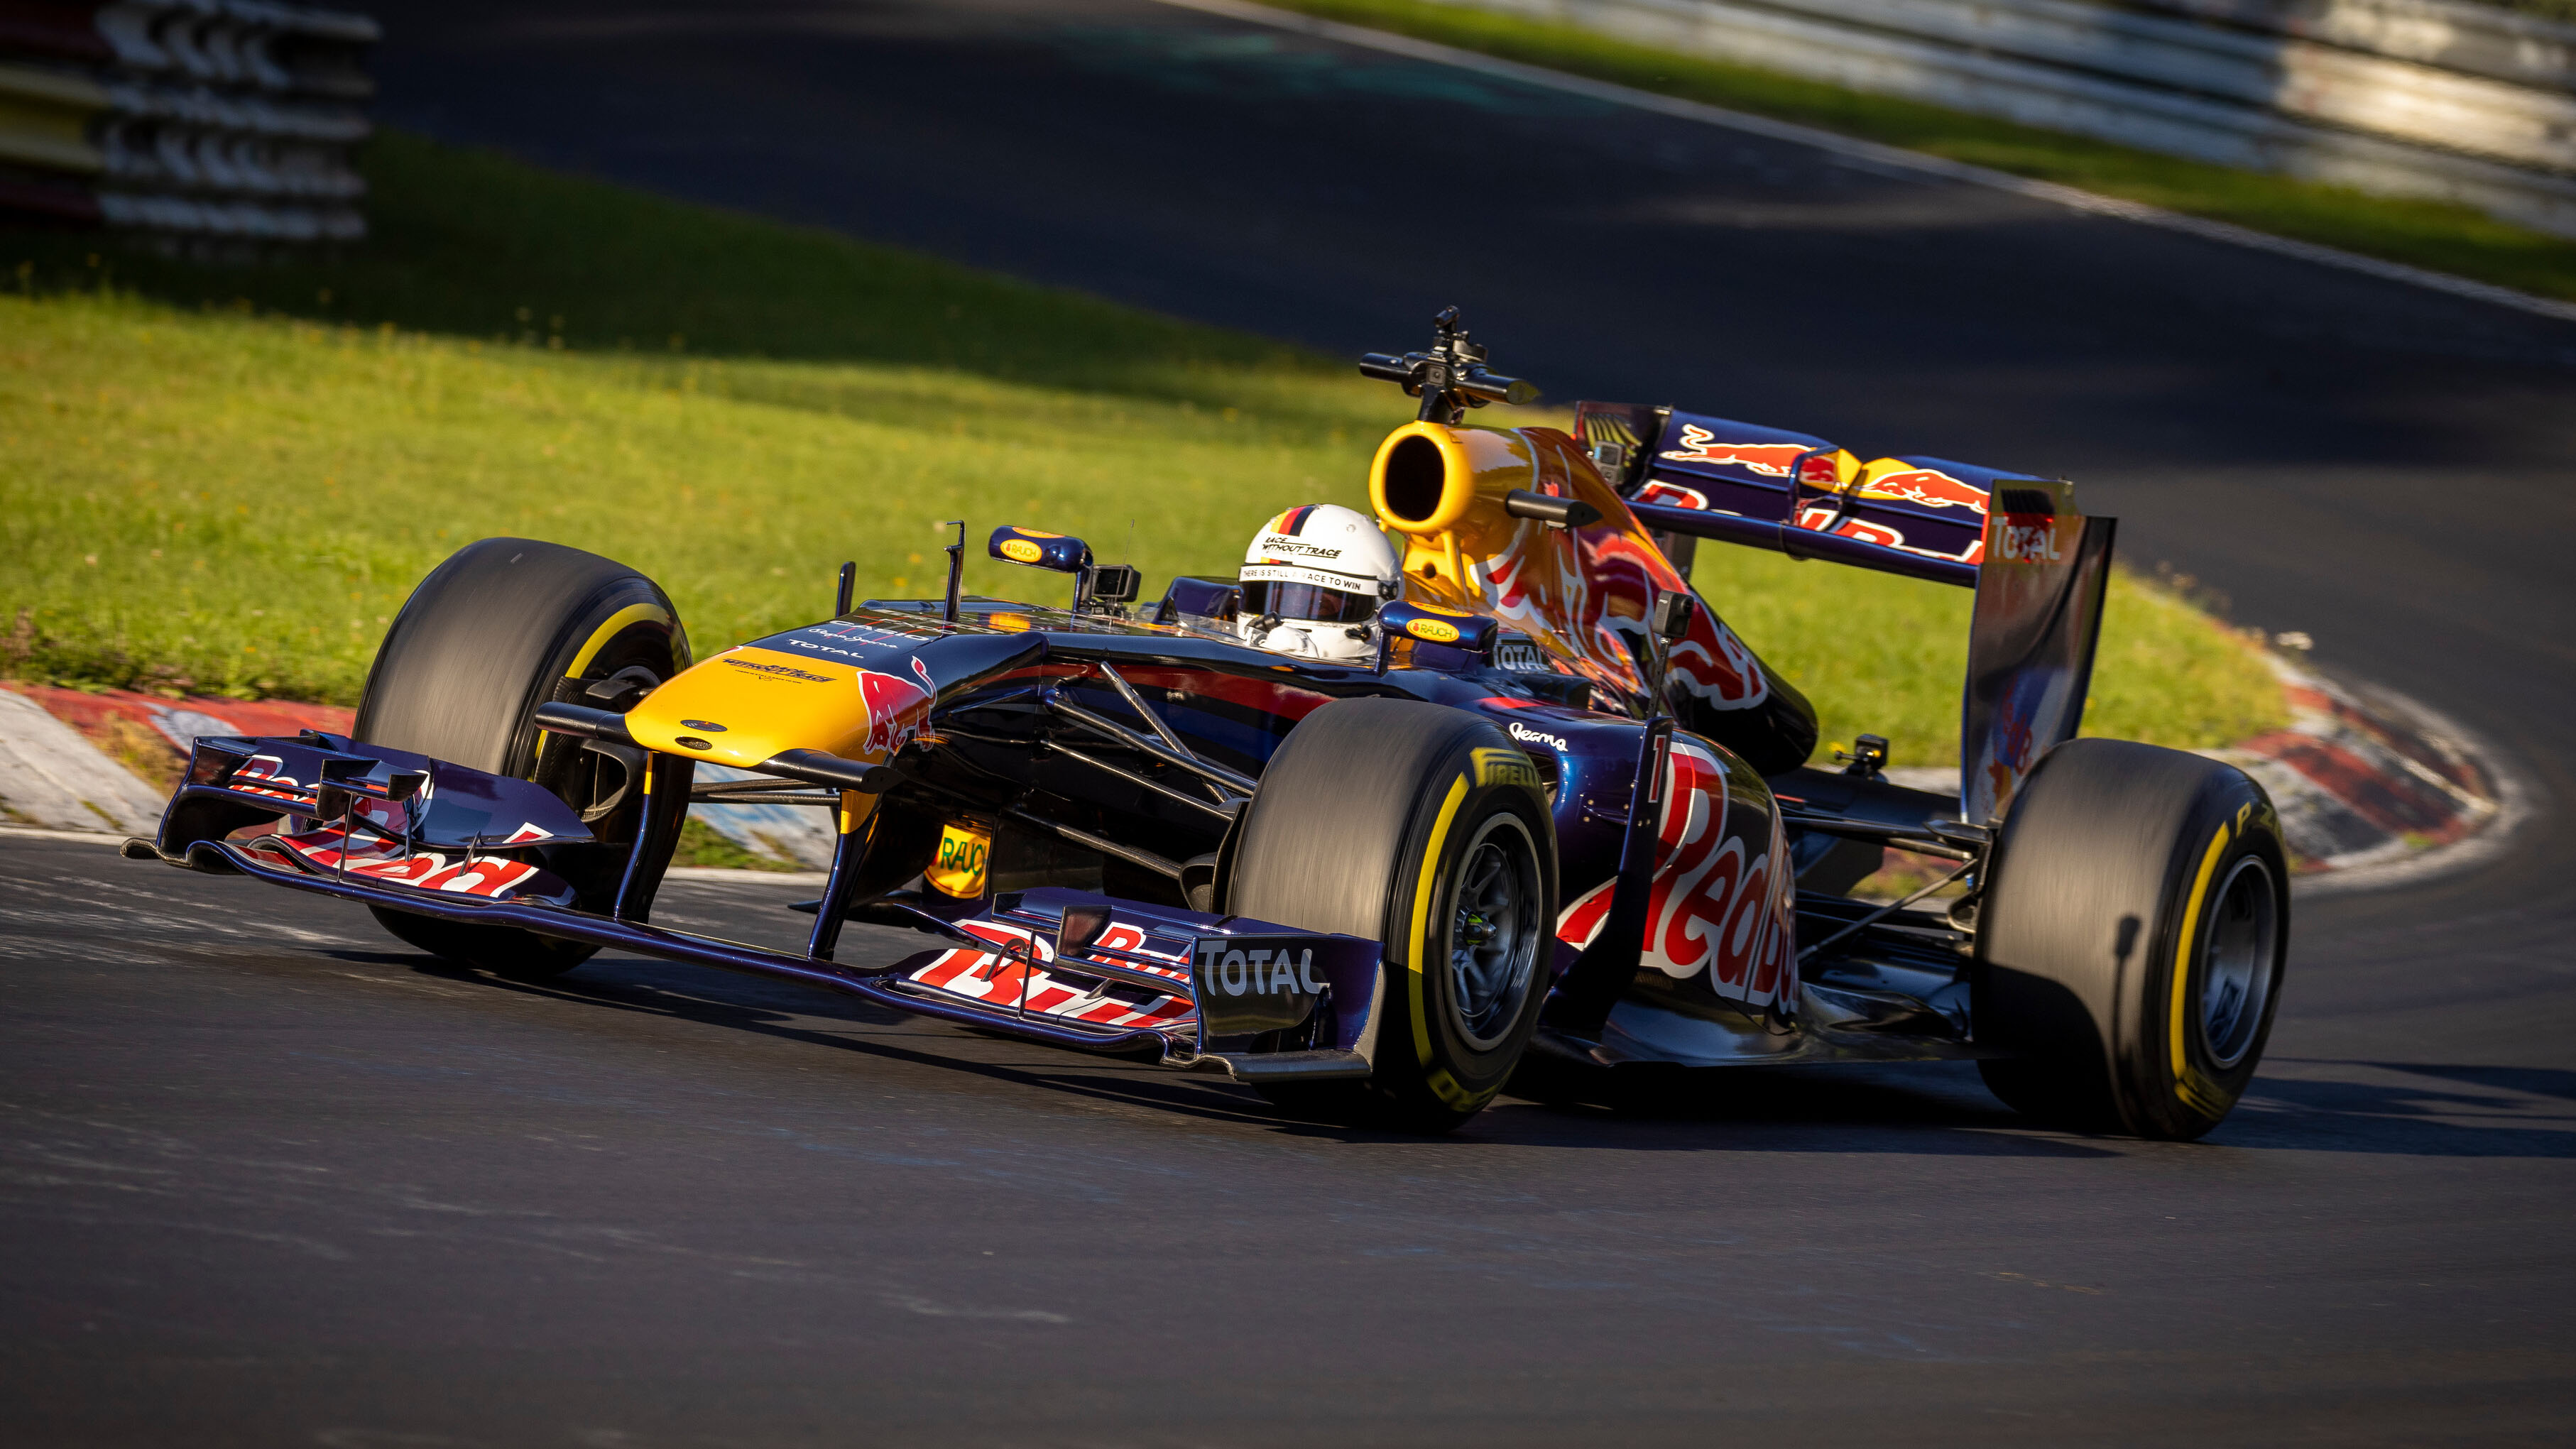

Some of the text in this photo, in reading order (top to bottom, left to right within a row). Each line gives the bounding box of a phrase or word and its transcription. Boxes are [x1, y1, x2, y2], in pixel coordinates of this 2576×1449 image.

[1262, 544, 1343, 557] WITHOUT TRACE
[1329, 576, 1341, 586] TO
[1343, 580, 1361, 591] WIN
[829, 620, 929, 641] CASIO
[1420, 624, 1453, 638] RAUCH
[789, 638, 864, 659] TOTAL
[1648, 734, 1667, 803] 1
[1199, 941, 1331, 996] TOTAL
